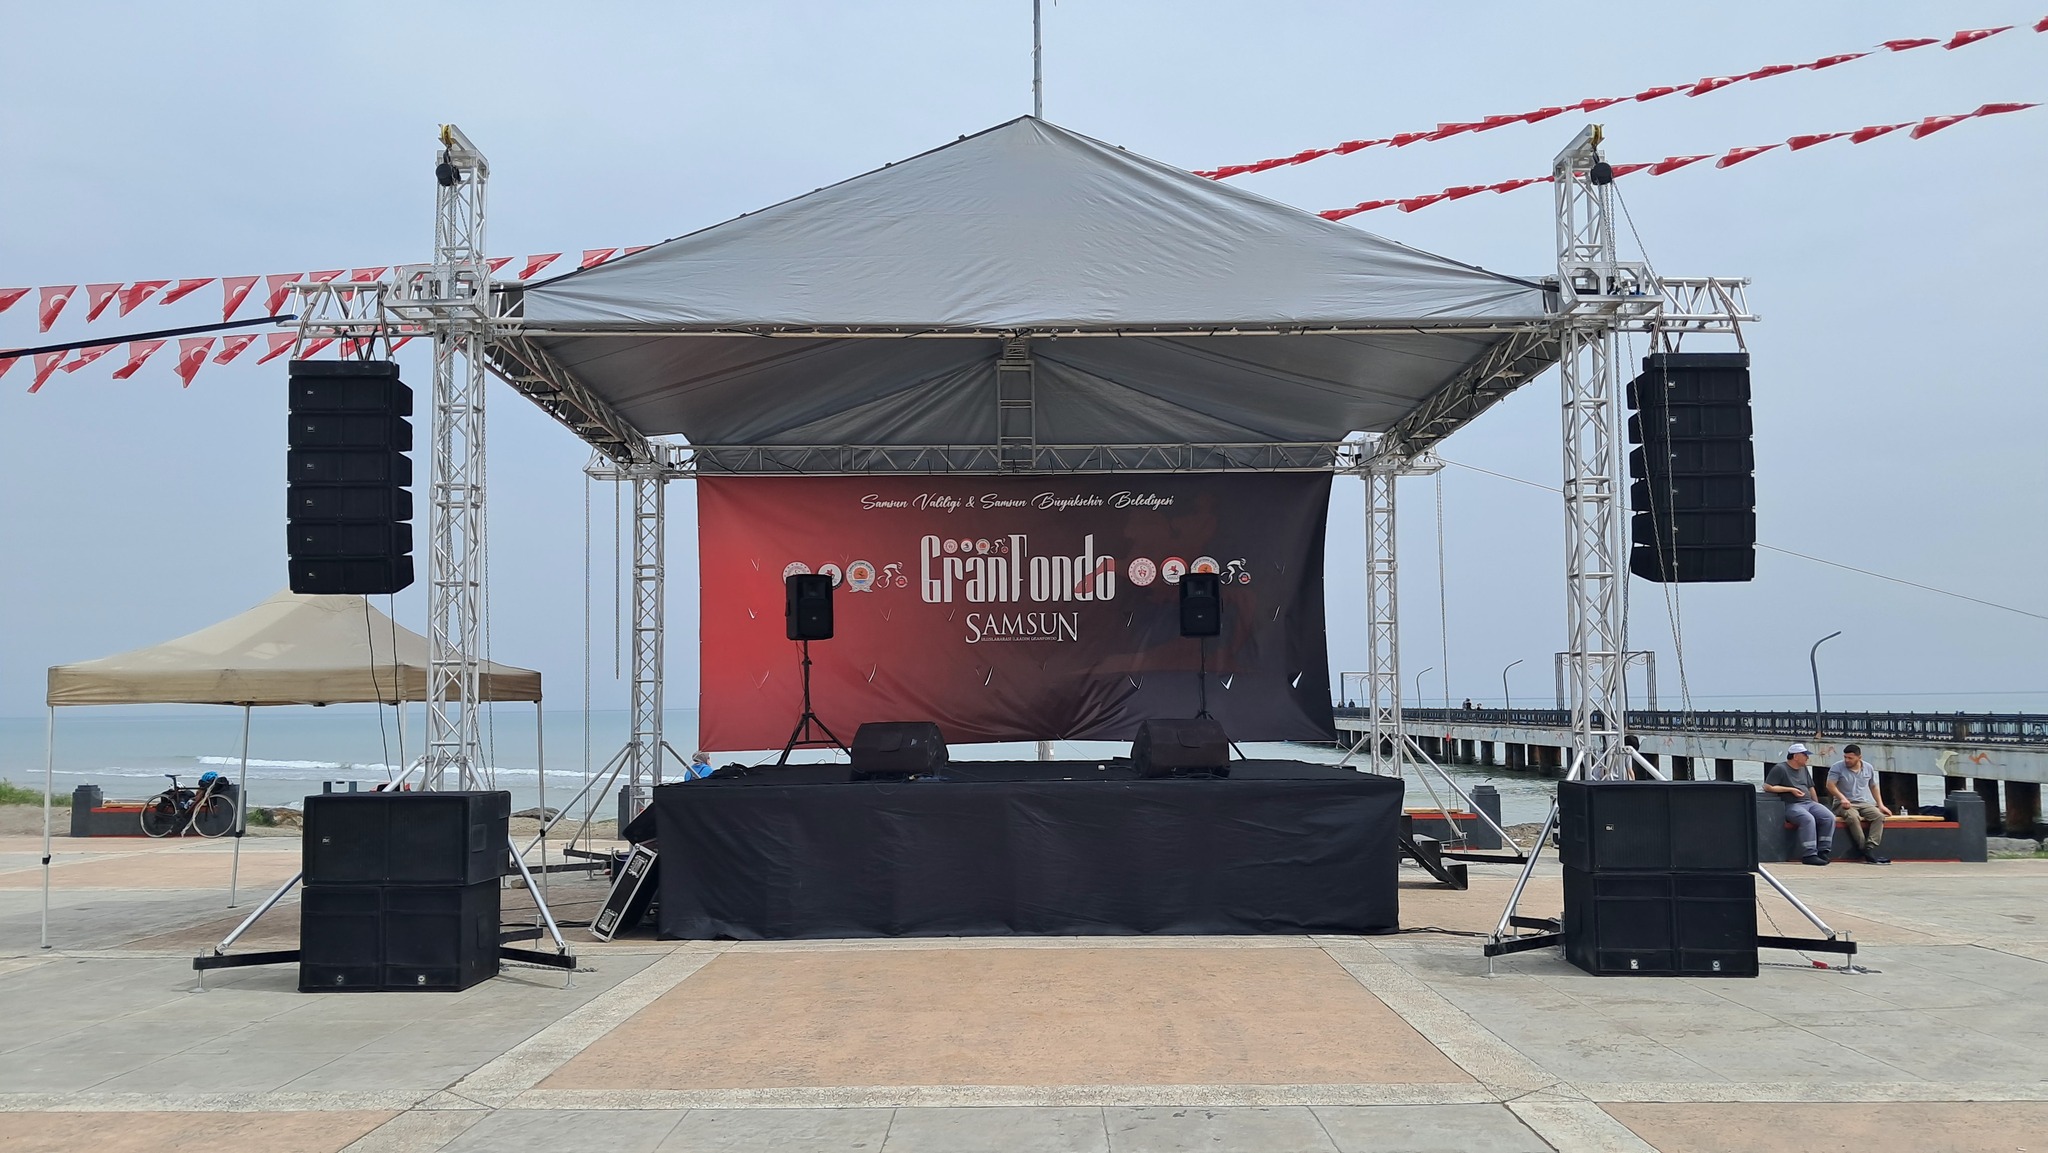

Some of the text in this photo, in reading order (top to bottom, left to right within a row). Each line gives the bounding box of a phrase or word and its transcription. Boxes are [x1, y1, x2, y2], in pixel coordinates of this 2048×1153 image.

[860, 493, 909, 510] Samsun
[965, 495, 976, 509] &
[980, 493, 1028, 510] Samsun
[1107, 491, 1175, 511] Belediyesi
[920, 533, 1117, 603] GranFondo
[965, 612, 1079, 644] SAMSUN
